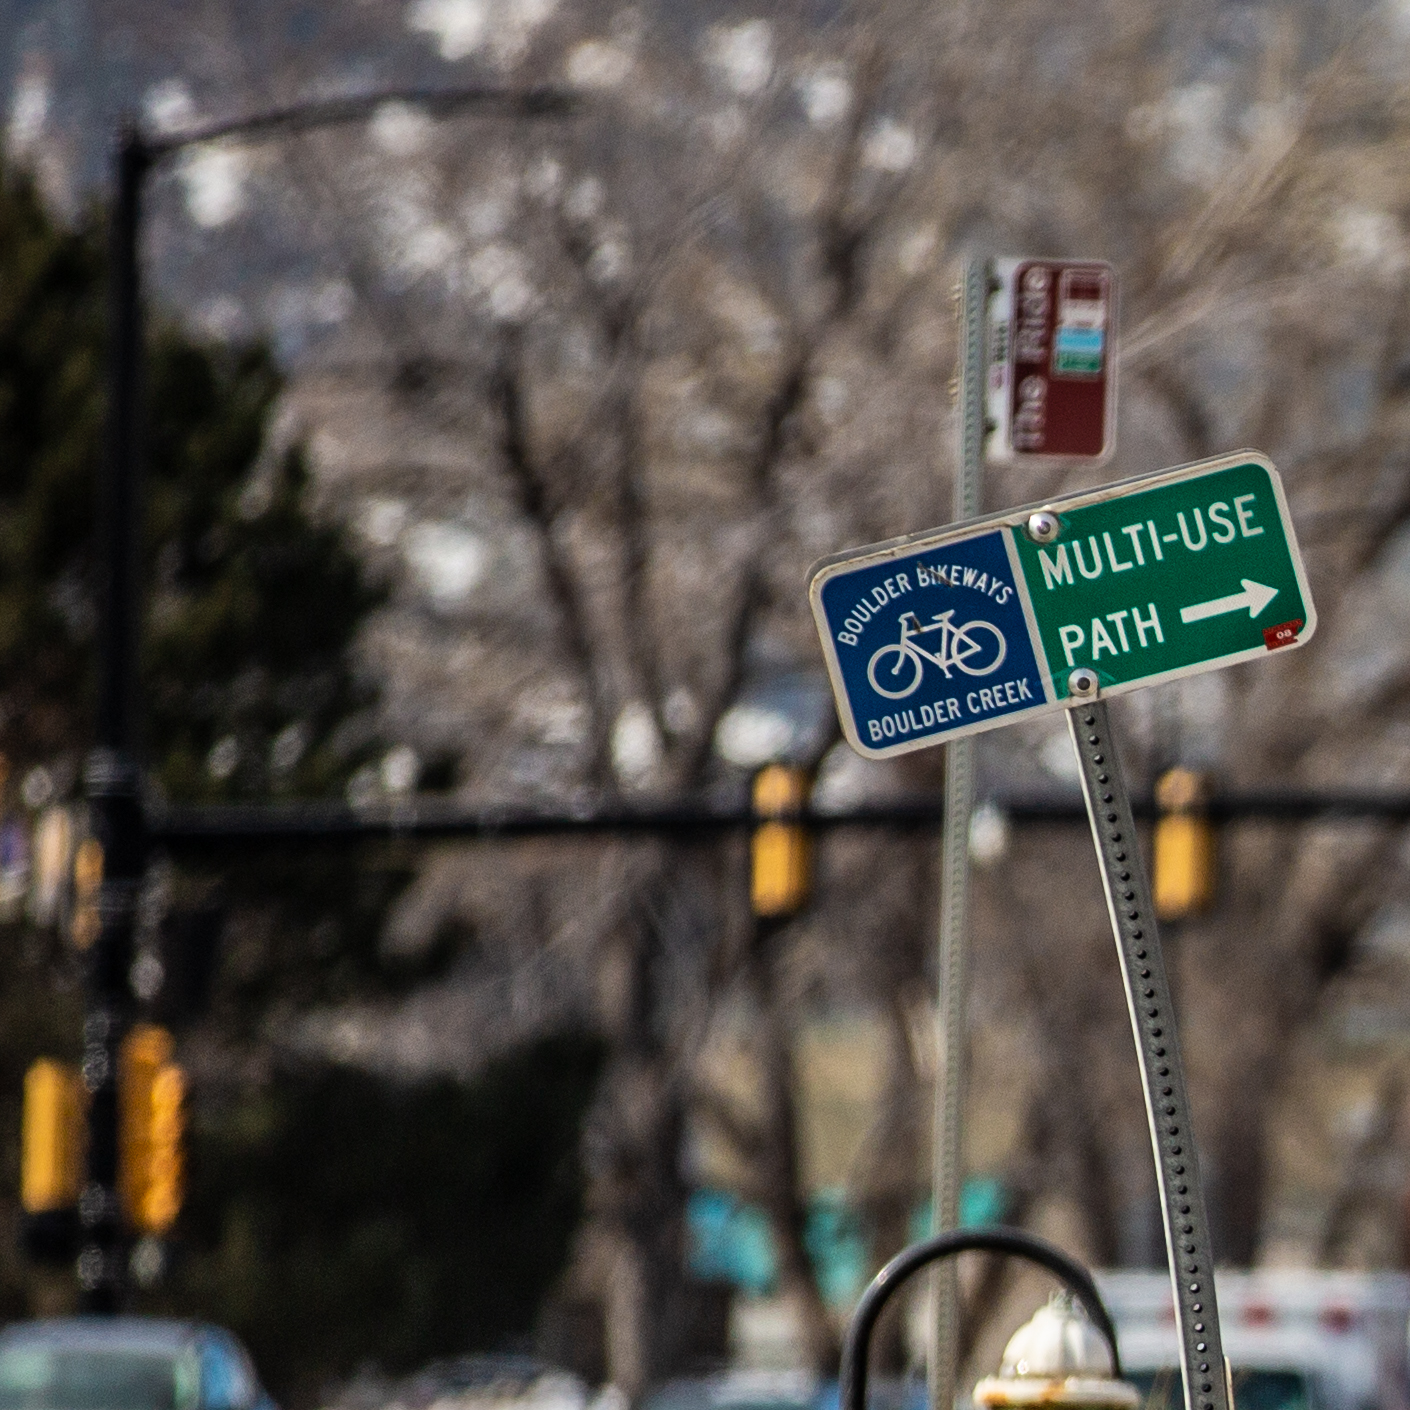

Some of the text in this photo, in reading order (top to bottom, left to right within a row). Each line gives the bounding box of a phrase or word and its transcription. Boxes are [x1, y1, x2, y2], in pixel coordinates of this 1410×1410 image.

[1037, 494, 1264, 590] MULTI-USE
[837, 564, 1013, 646] BOULDER BIKEWAYS
[1058, 603, 1165, 667] PATH
[867, 678, 1033, 741] BOULDER CREEK
